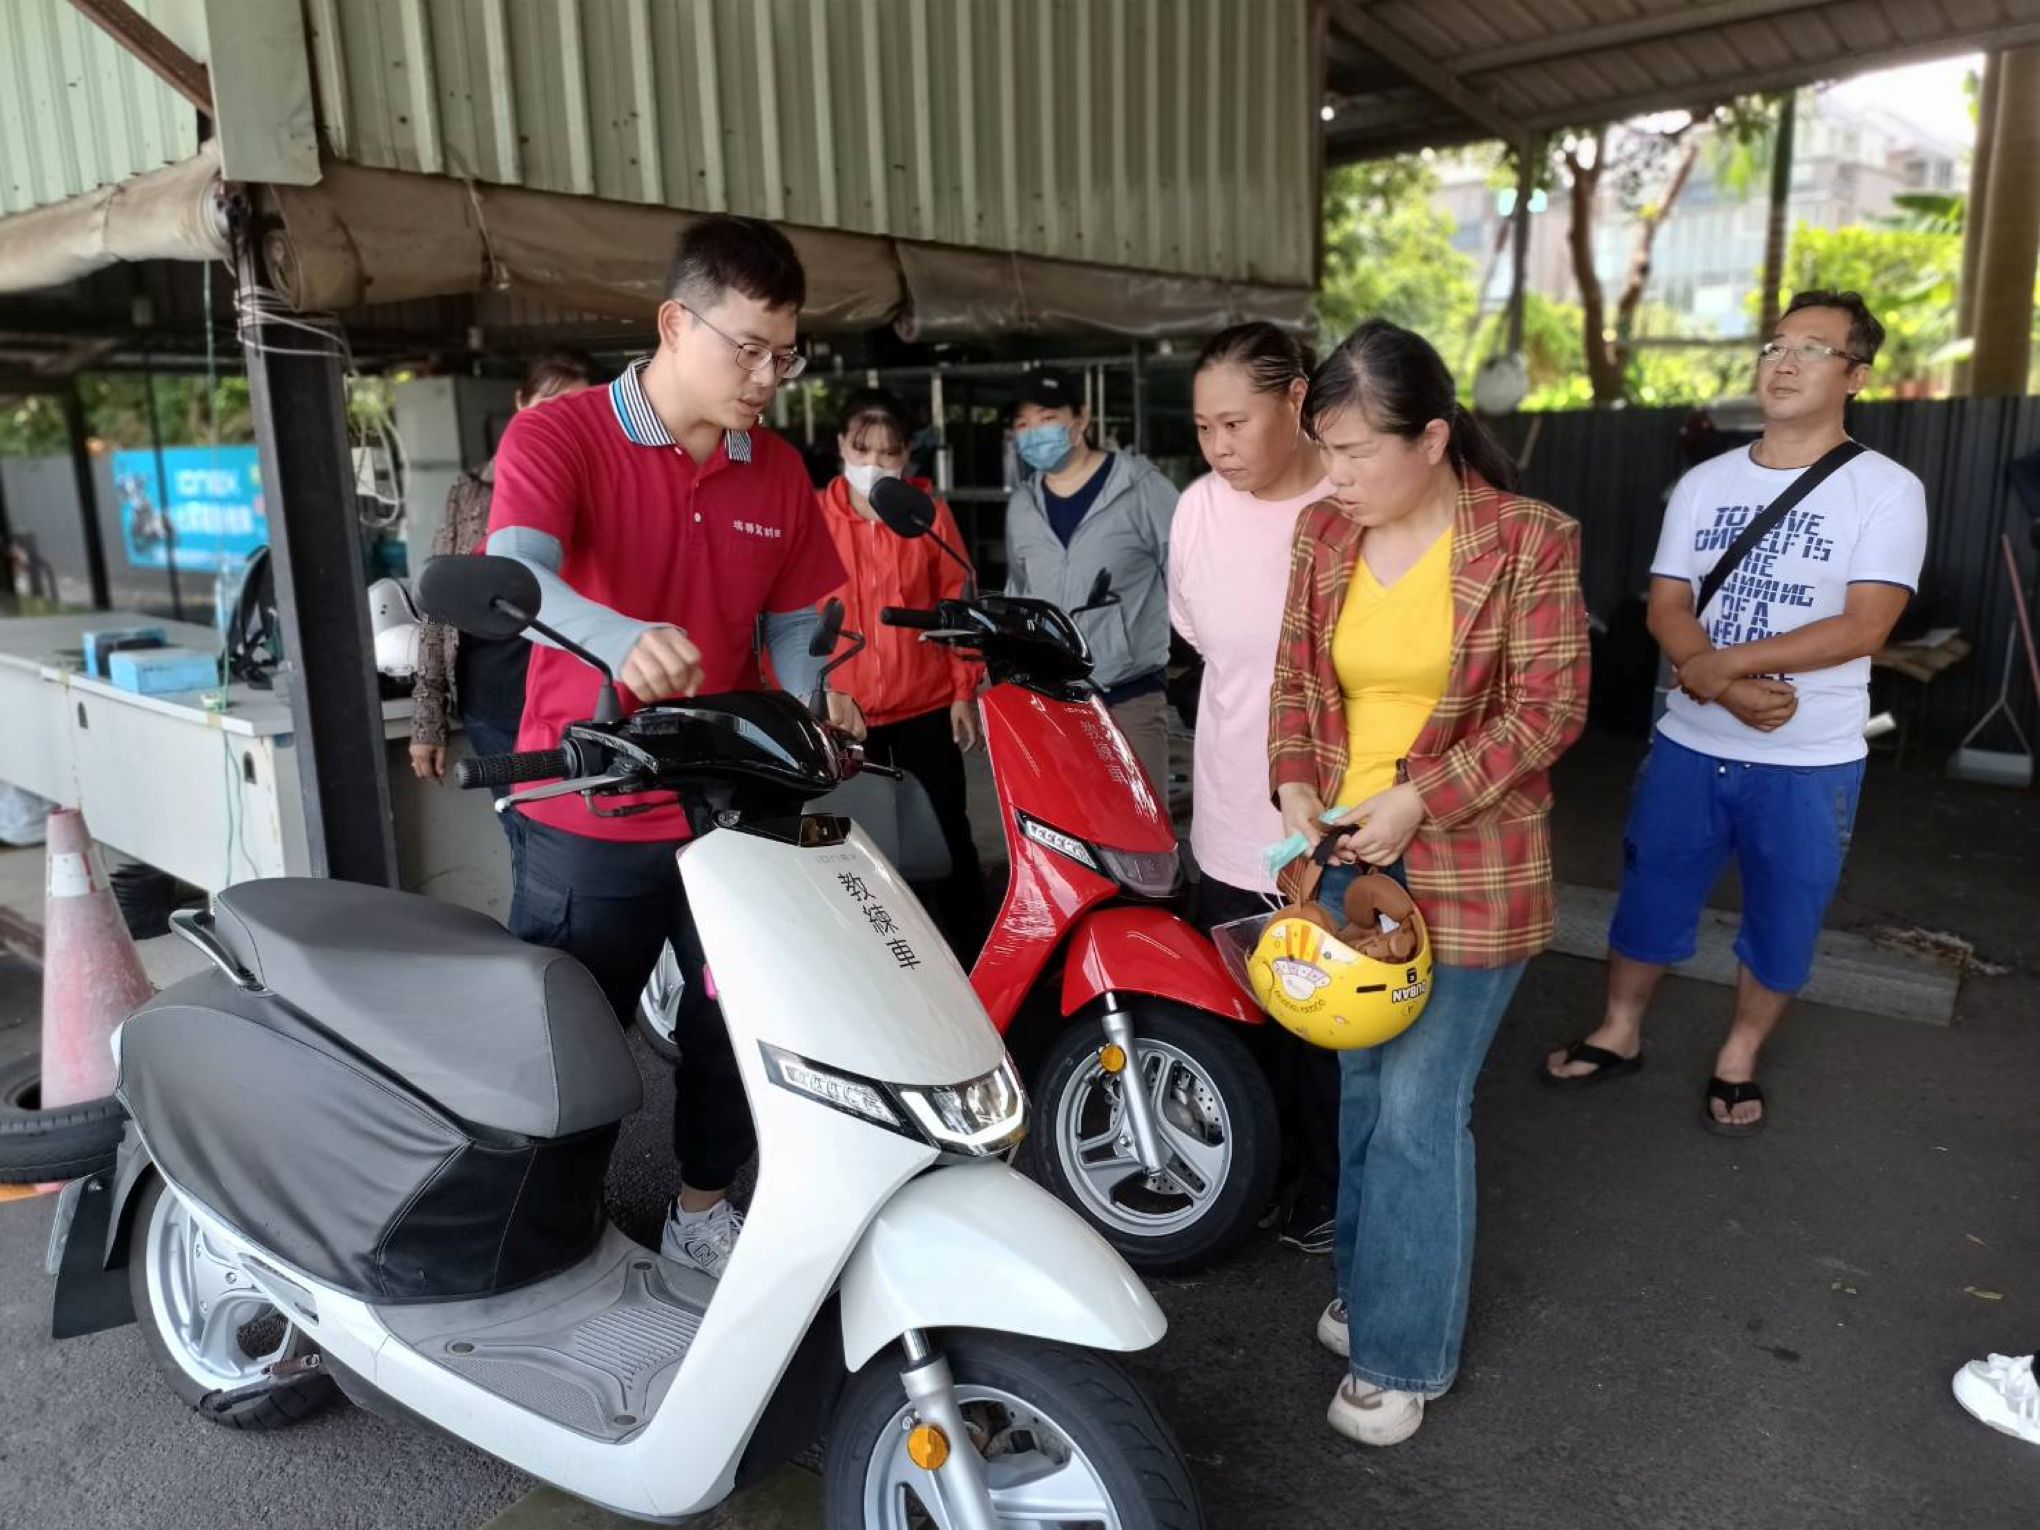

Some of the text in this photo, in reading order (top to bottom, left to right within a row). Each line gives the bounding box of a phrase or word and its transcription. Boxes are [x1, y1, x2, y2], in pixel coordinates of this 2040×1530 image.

[1715, 505, 1825, 536] TO VE
[1694, 526, 1834, 562] ONEELF IS
[1742, 550, 1778, 577] HE
[1698, 572, 1815, 607] INNING
[1721, 594, 1769, 628] OF A
[835, 871, 922, 970] 教練車
